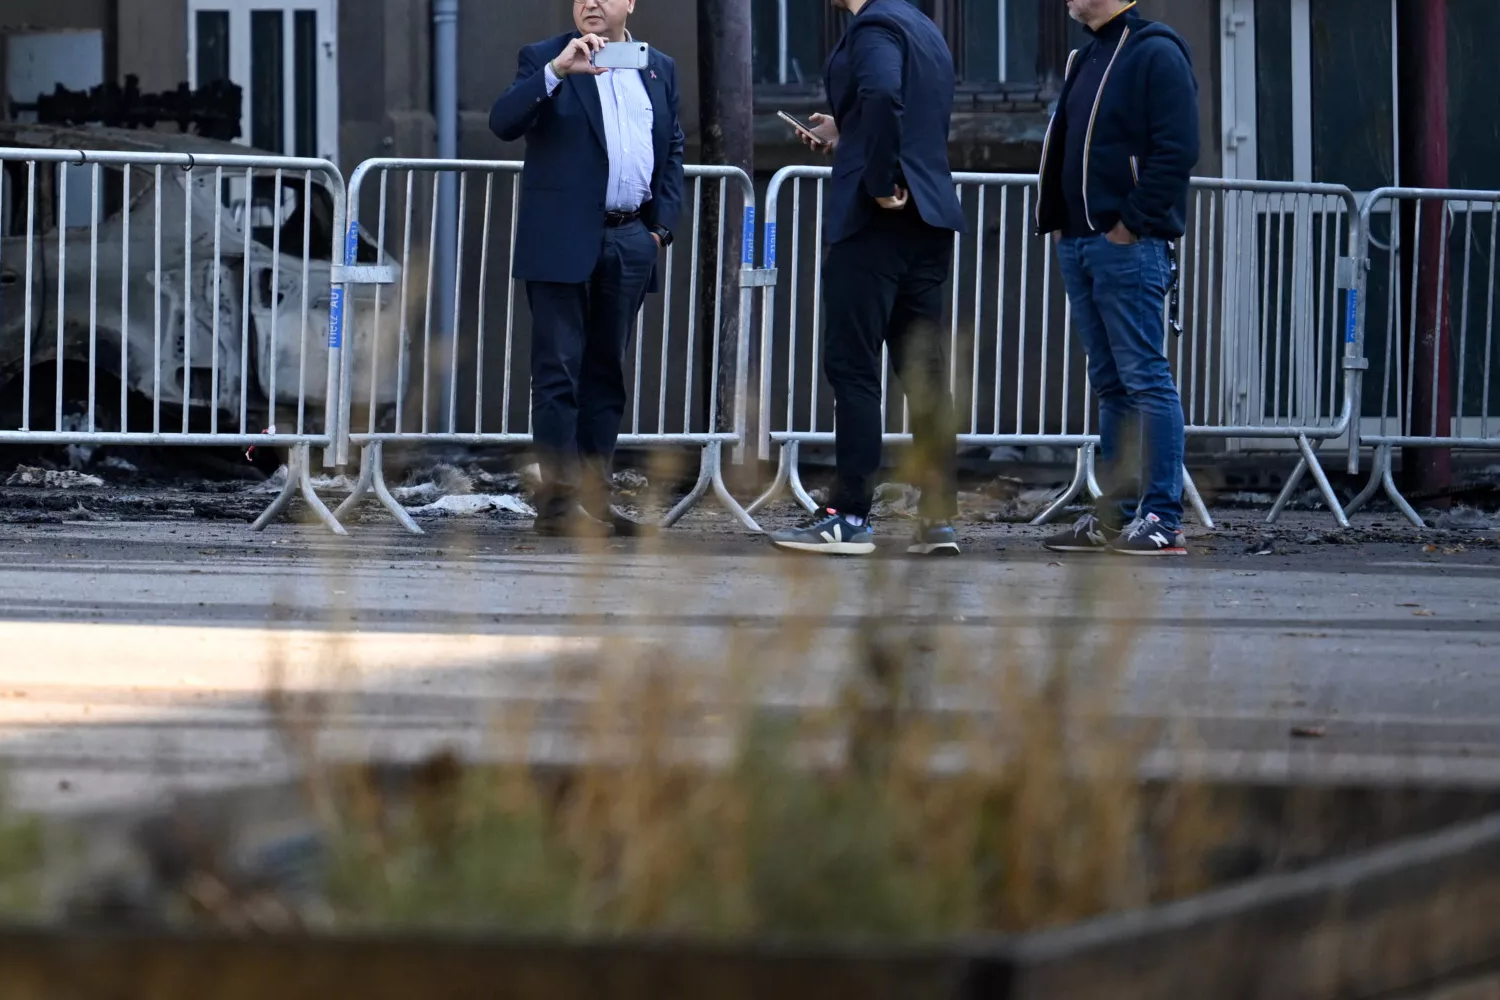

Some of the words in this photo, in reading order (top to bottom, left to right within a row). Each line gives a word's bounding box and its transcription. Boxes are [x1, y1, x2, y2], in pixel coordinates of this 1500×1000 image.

[330, 292, 339, 308] AU
[329, 315, 338, 344] metz
[1148, 531, 1169, 548] N
